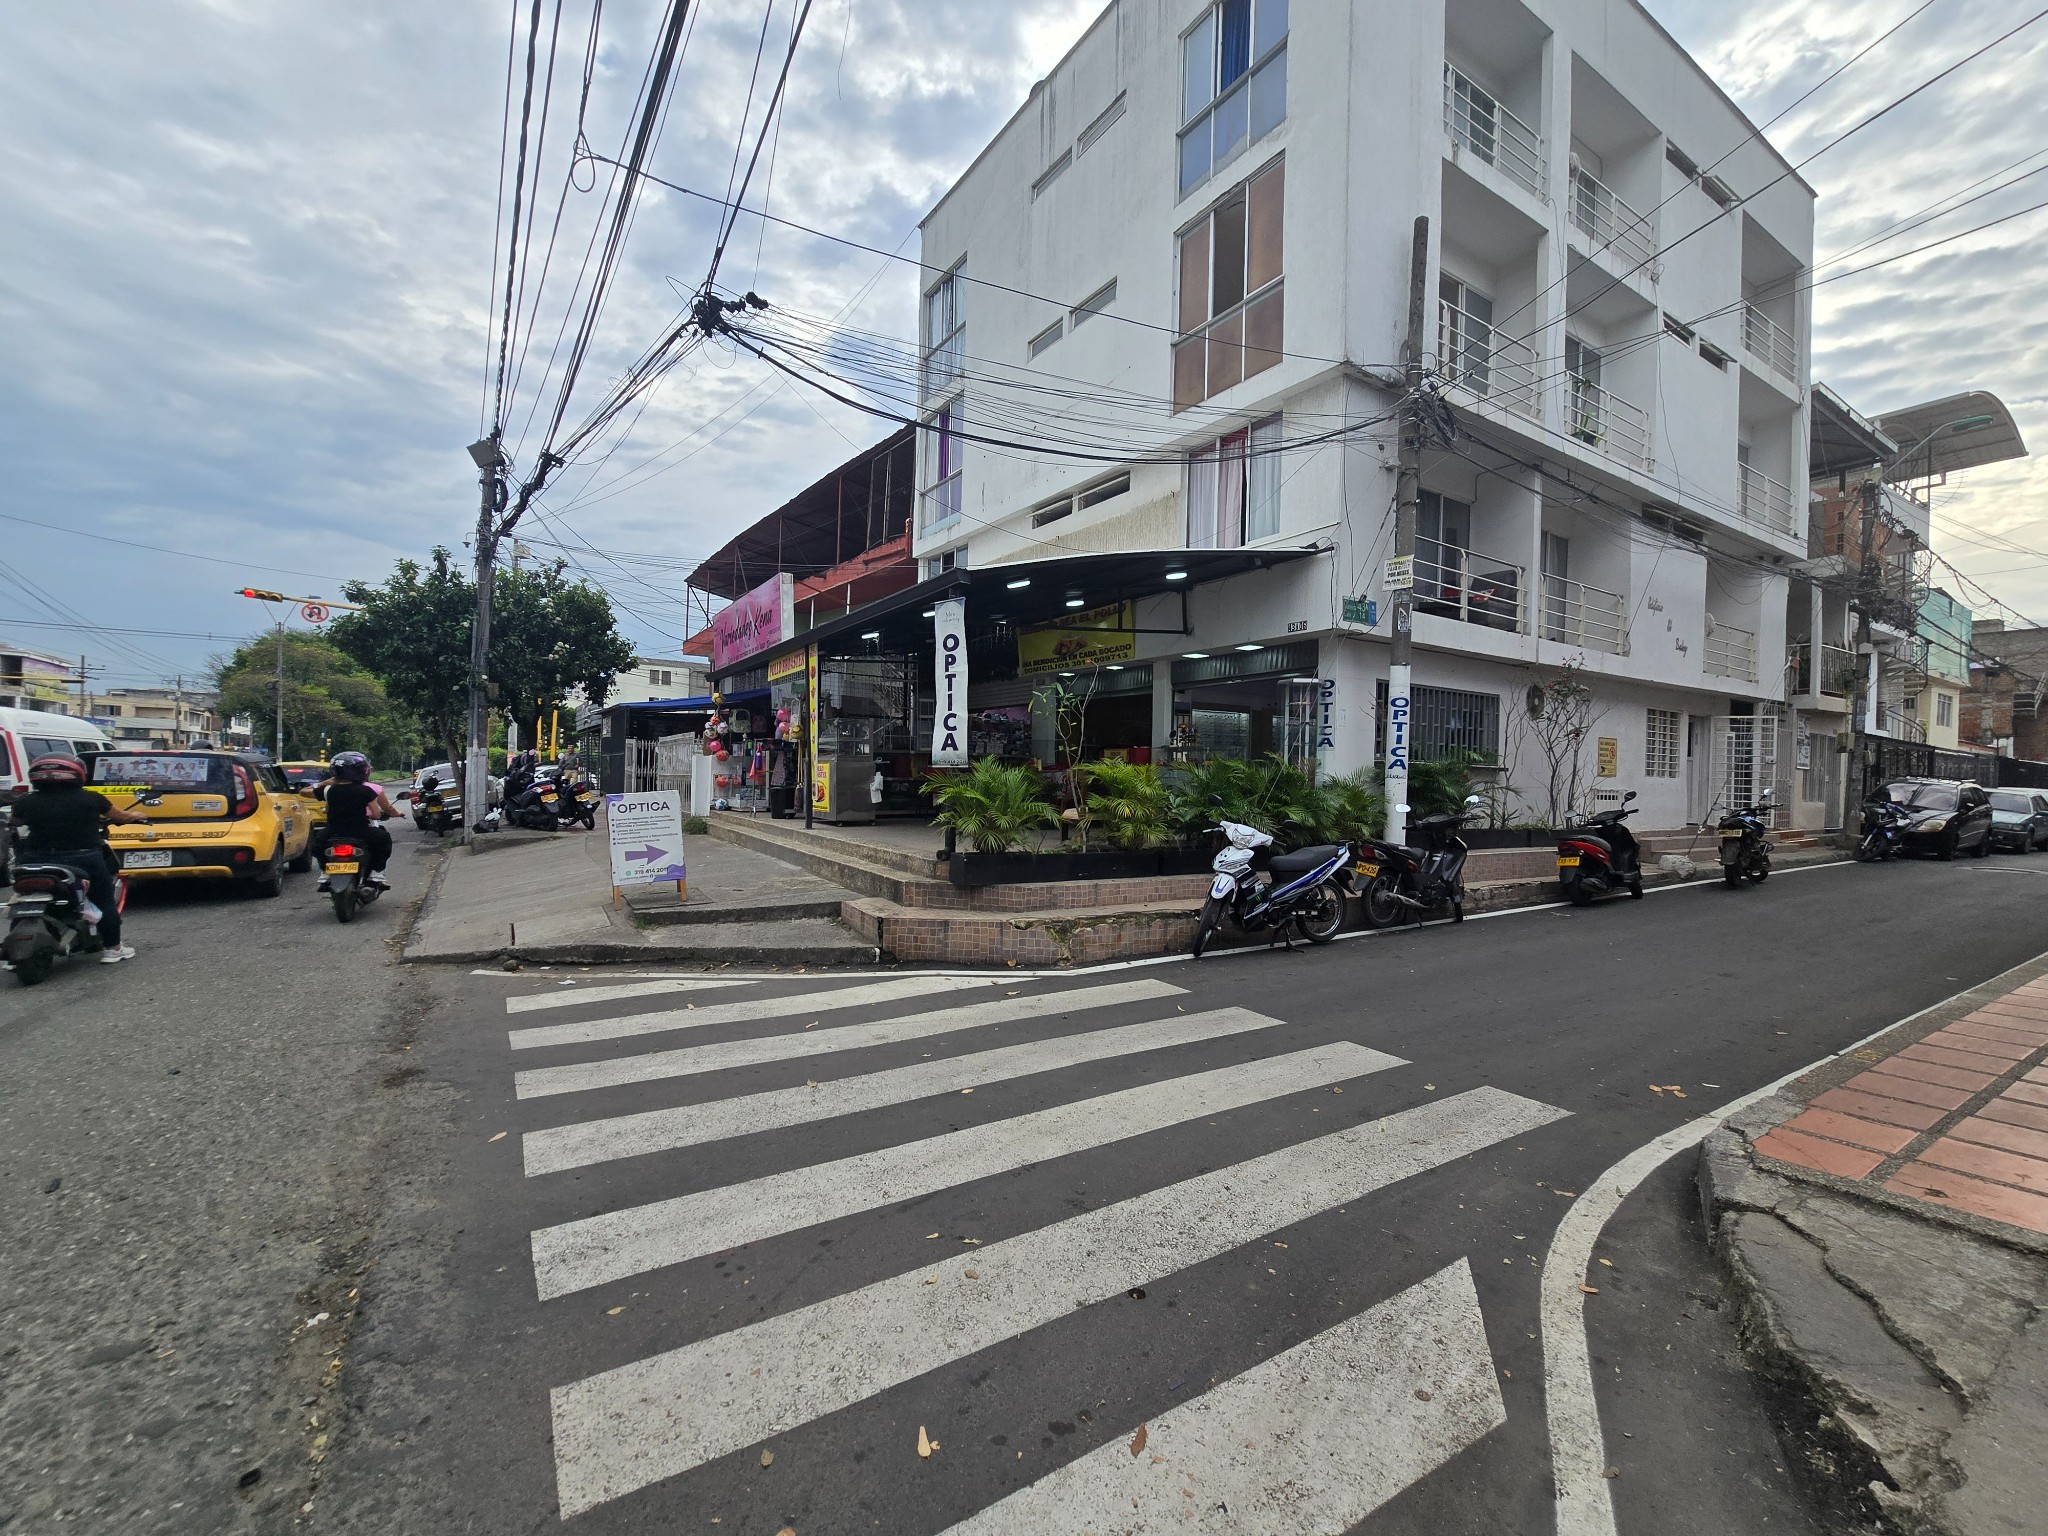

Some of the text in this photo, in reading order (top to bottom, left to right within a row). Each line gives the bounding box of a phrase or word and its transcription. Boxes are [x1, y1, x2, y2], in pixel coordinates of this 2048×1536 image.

[1024, 662, 1070, 674] DOMICILIOS
[1079, 649, 1098, 659] CADA
[1099, 643, 1132, 655] BOCADO
[941, 633, 960, 751] OPTICA
[1317, 679, 1335, 748] OPTICA
[1388, 697, 1410, 770] OPTICA
[617, 801, 670, 814] OPTICA
